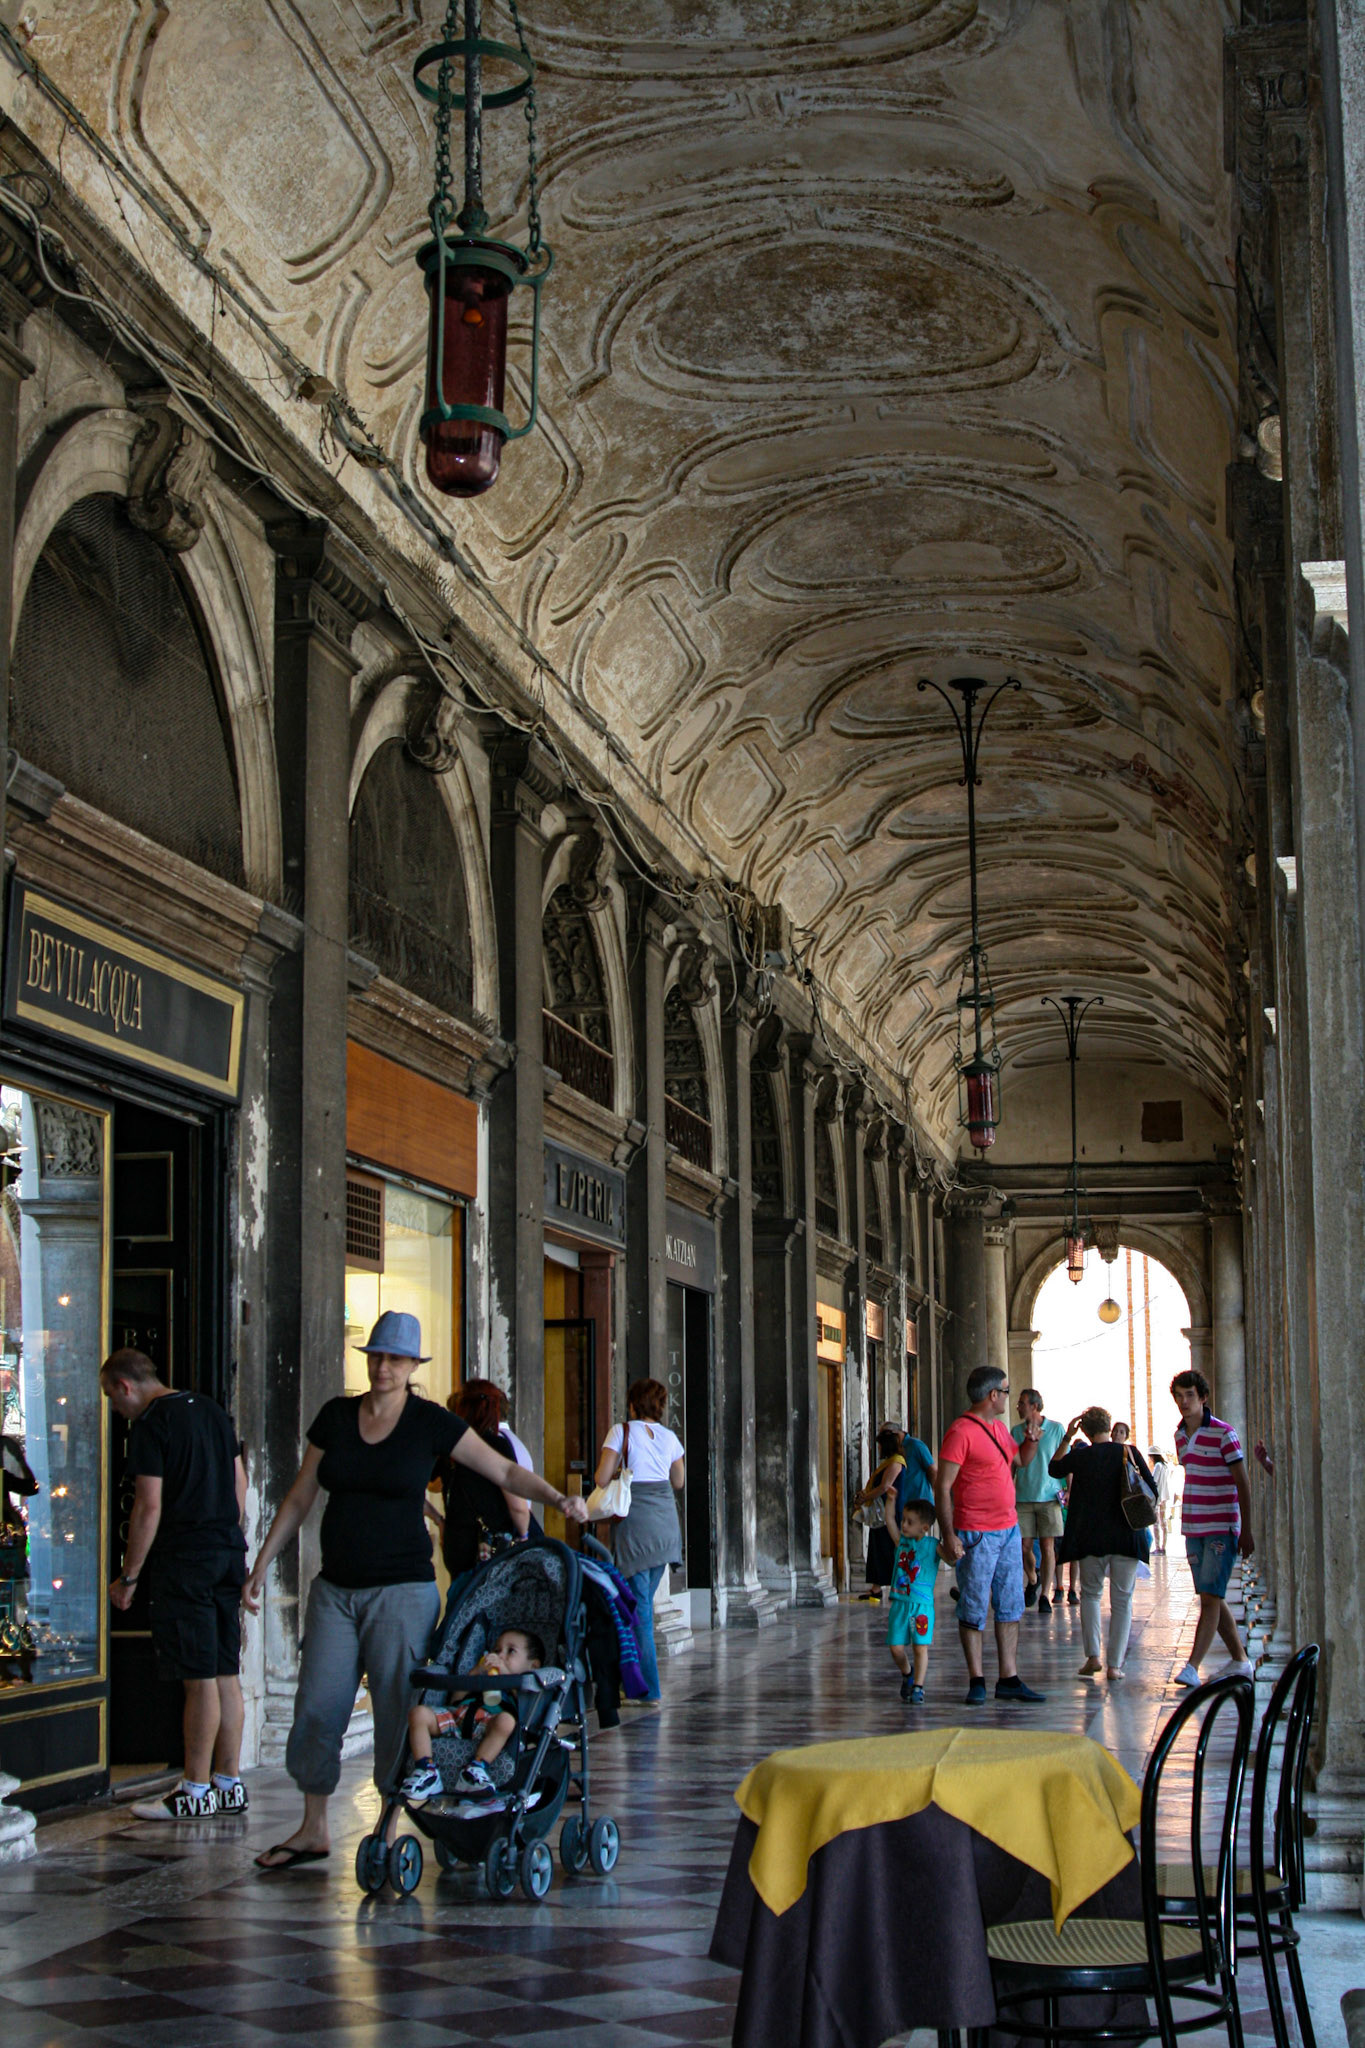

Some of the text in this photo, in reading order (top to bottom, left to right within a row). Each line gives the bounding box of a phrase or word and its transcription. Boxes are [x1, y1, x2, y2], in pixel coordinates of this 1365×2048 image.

[26, 928, 143, 1033] BEVILACQUA
[665, 1234, 697, 1269] KATZIAN
[668, 1351, 682, 1428] TOKA
